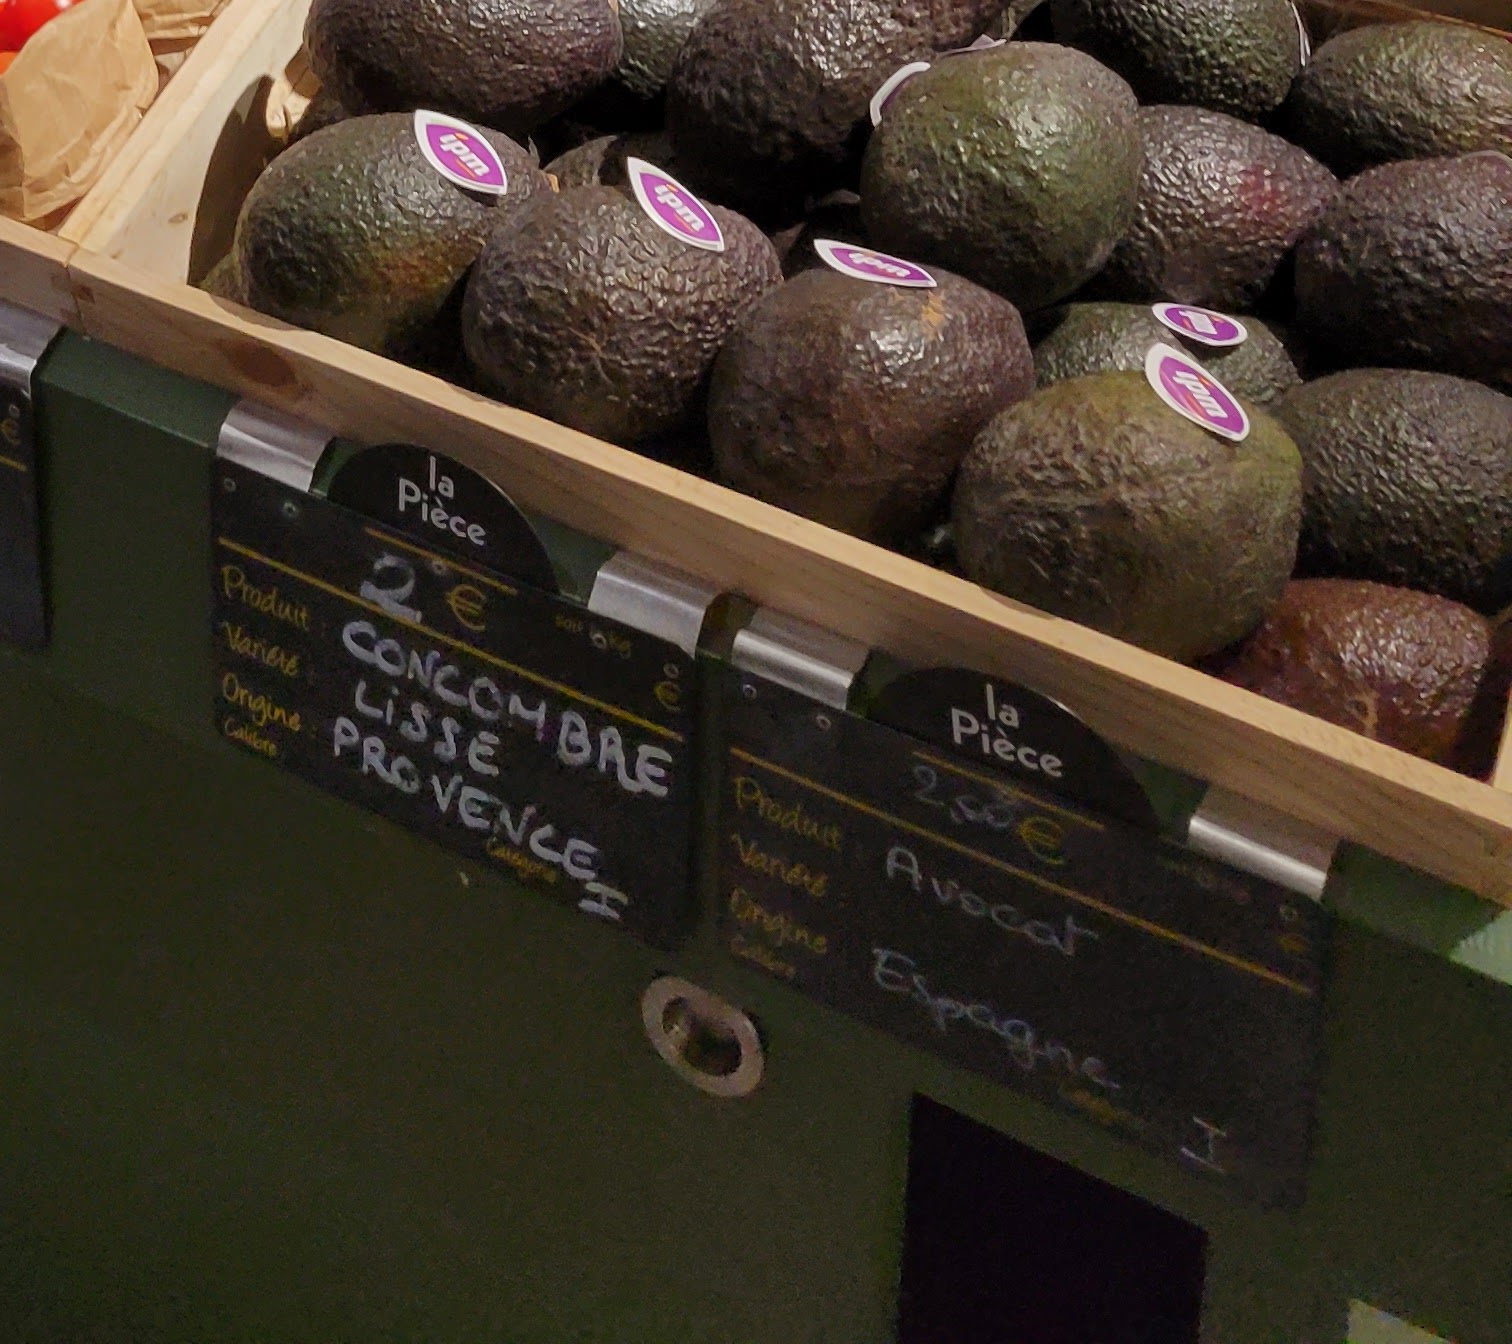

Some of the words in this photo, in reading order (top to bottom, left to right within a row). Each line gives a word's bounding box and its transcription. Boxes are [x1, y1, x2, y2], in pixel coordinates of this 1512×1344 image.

[439, 131, 491, 178] ipm
[653, 183, 705, 233] ipm
[1172, 369, 1229, 419] ipm
[429, 455, 455, 499] la
[398, 479, 487, 547] Pièce
[221, 564, 312, 631] Produit
[359, 552, 423, 623] 2
[447, 582, 487, 631] €
[222, 672, 303, 732] Origine
[341, 620, 673, 798] CONCOMBRE
[984, 683, 1020, 730] la
[950, 706, 1064, 779] Pièce
[333, 716, 602, 880] PROVENCE
[886, 845, 1100, 957] Avocat
